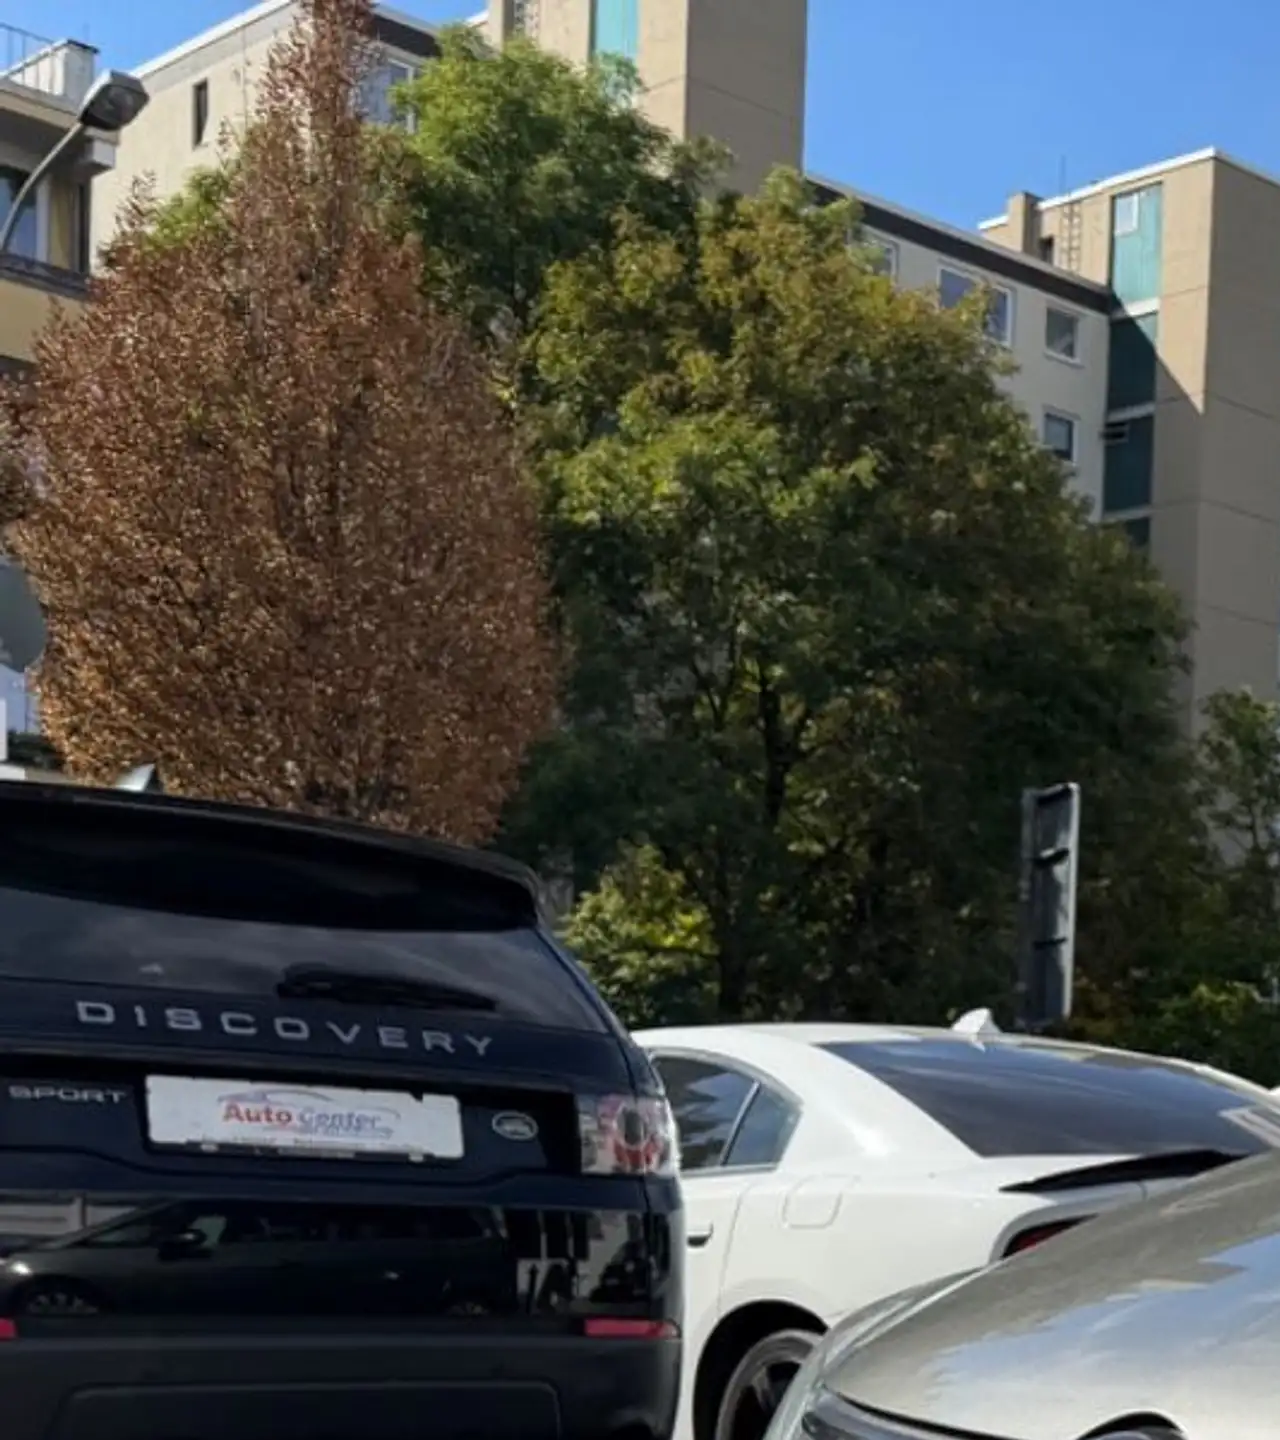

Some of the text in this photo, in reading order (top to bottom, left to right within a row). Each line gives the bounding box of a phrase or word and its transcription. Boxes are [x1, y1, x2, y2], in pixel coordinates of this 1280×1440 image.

[75, 1000, 493, 1056] DISCOVERY
[8, 1085, 127, 1103] SPORT
[222, 1102, 382, 1132] Auto Center
